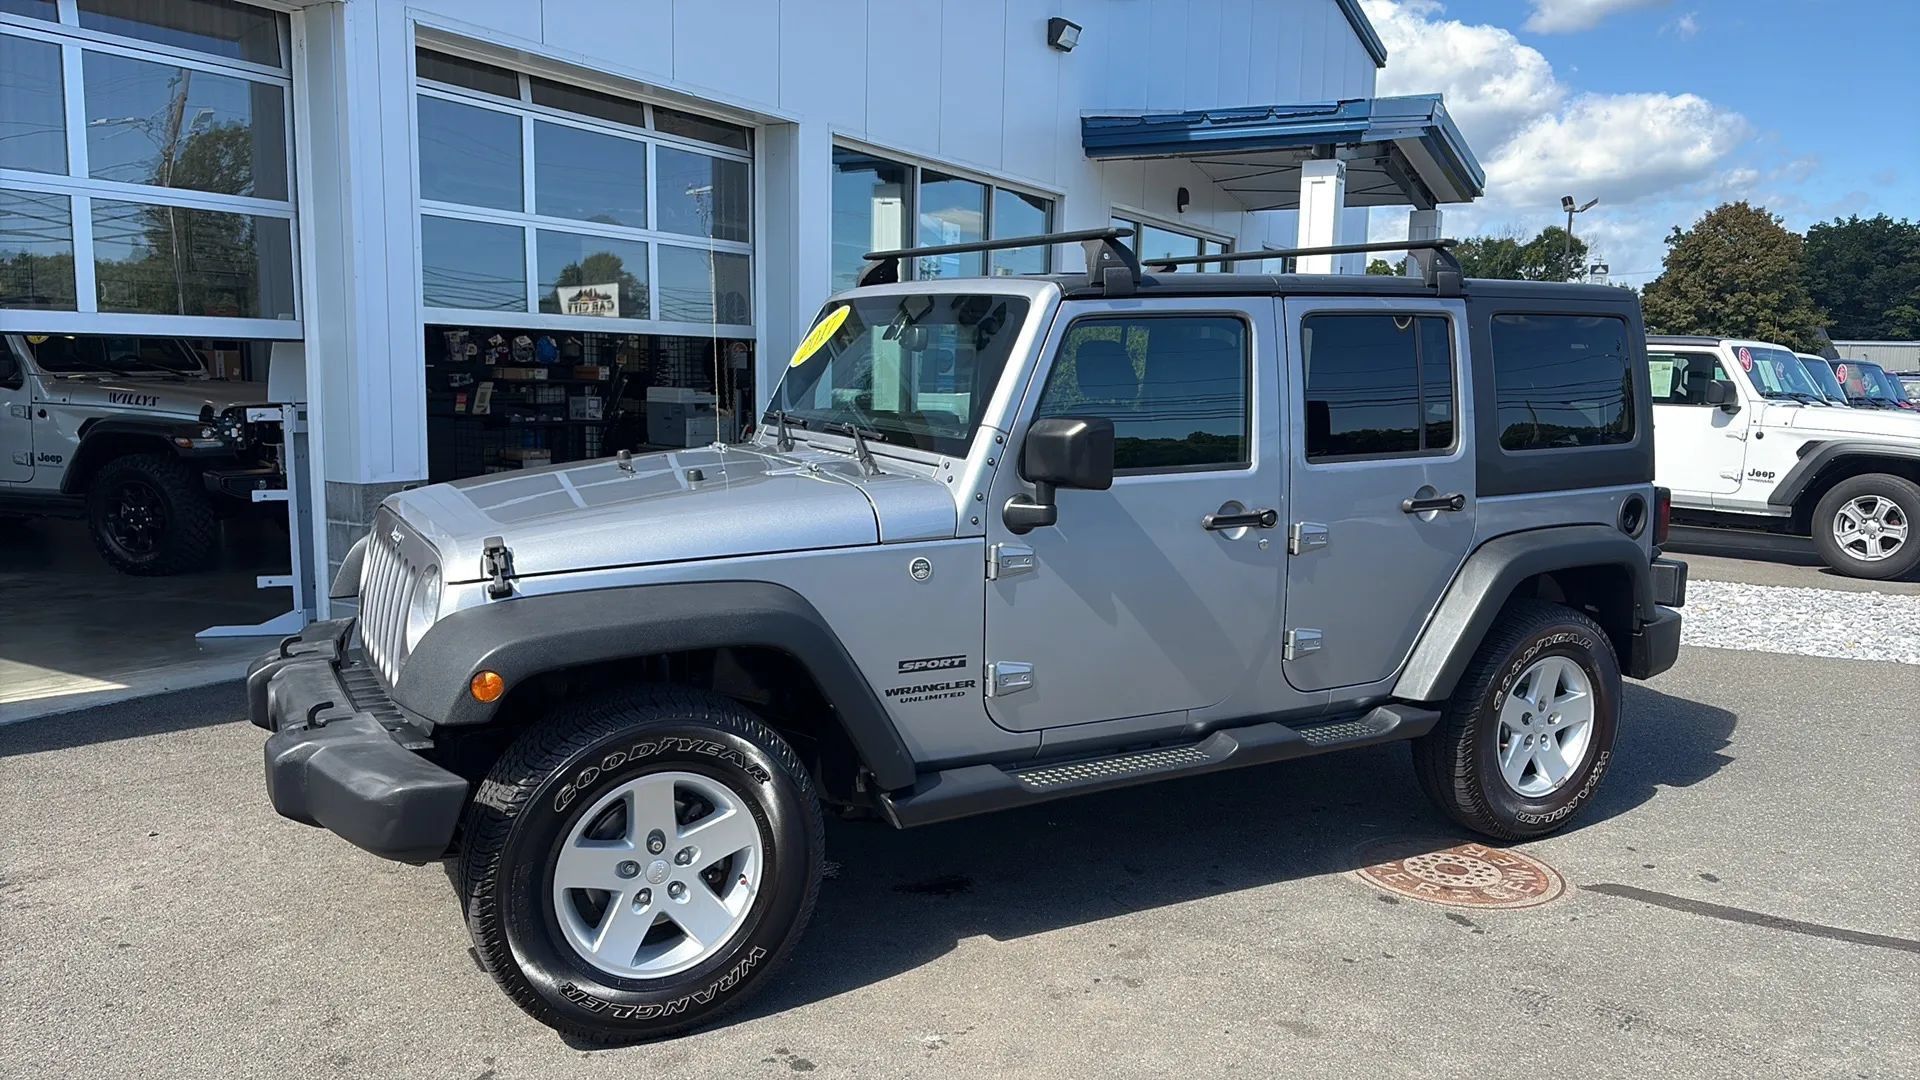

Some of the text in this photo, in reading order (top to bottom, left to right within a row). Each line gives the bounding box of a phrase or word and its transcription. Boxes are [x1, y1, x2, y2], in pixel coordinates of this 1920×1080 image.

[109, 392, 160, 407] WILLYS
[38, 452, 63, 464] Jeep
[1747, 468, 1775, 479] Jeep
[902, 659, 961, 671] SPORT
[885, 680, 976, 697] WRANGLER
[900, 691, 966, 704] UNLIMITED
[554, 737, 771, 812] GOODYEAR
[1516, 751, 1610, 824] WRANGLER
[558, 945, 767, 1020] WRANGLER
